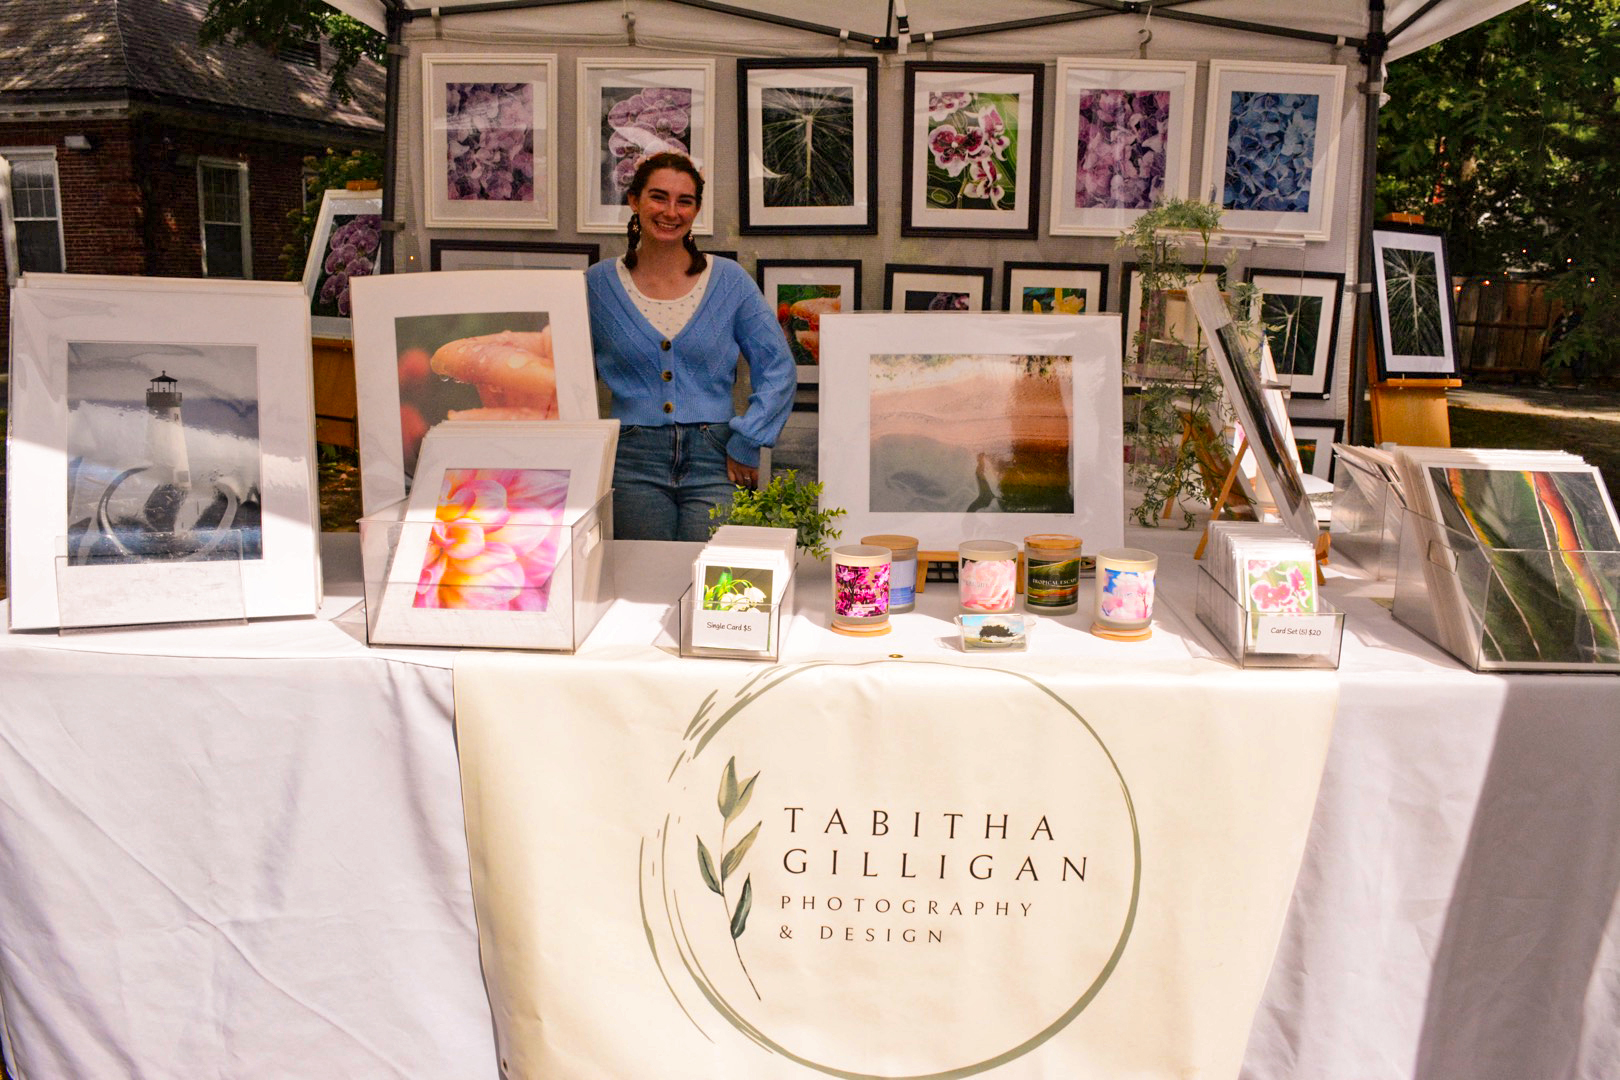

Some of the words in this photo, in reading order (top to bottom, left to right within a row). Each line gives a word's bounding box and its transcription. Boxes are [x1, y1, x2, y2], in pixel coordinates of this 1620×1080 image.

[1032, 578, 1058, 586] TROPICAL
[706, 621, 725, 631] Single
[726, 623, 742, 631] Card
[743, 624, 752, 632] $5
[783, 806, 1055, 841] TABITHA
[783, 848, 1087, 882] GILLIGAN
[781, 895, 1032, 917] PHOTOGRAPHY
[779, 925, 793, 939] &
[820, 925, 942, 943] DESIGN
